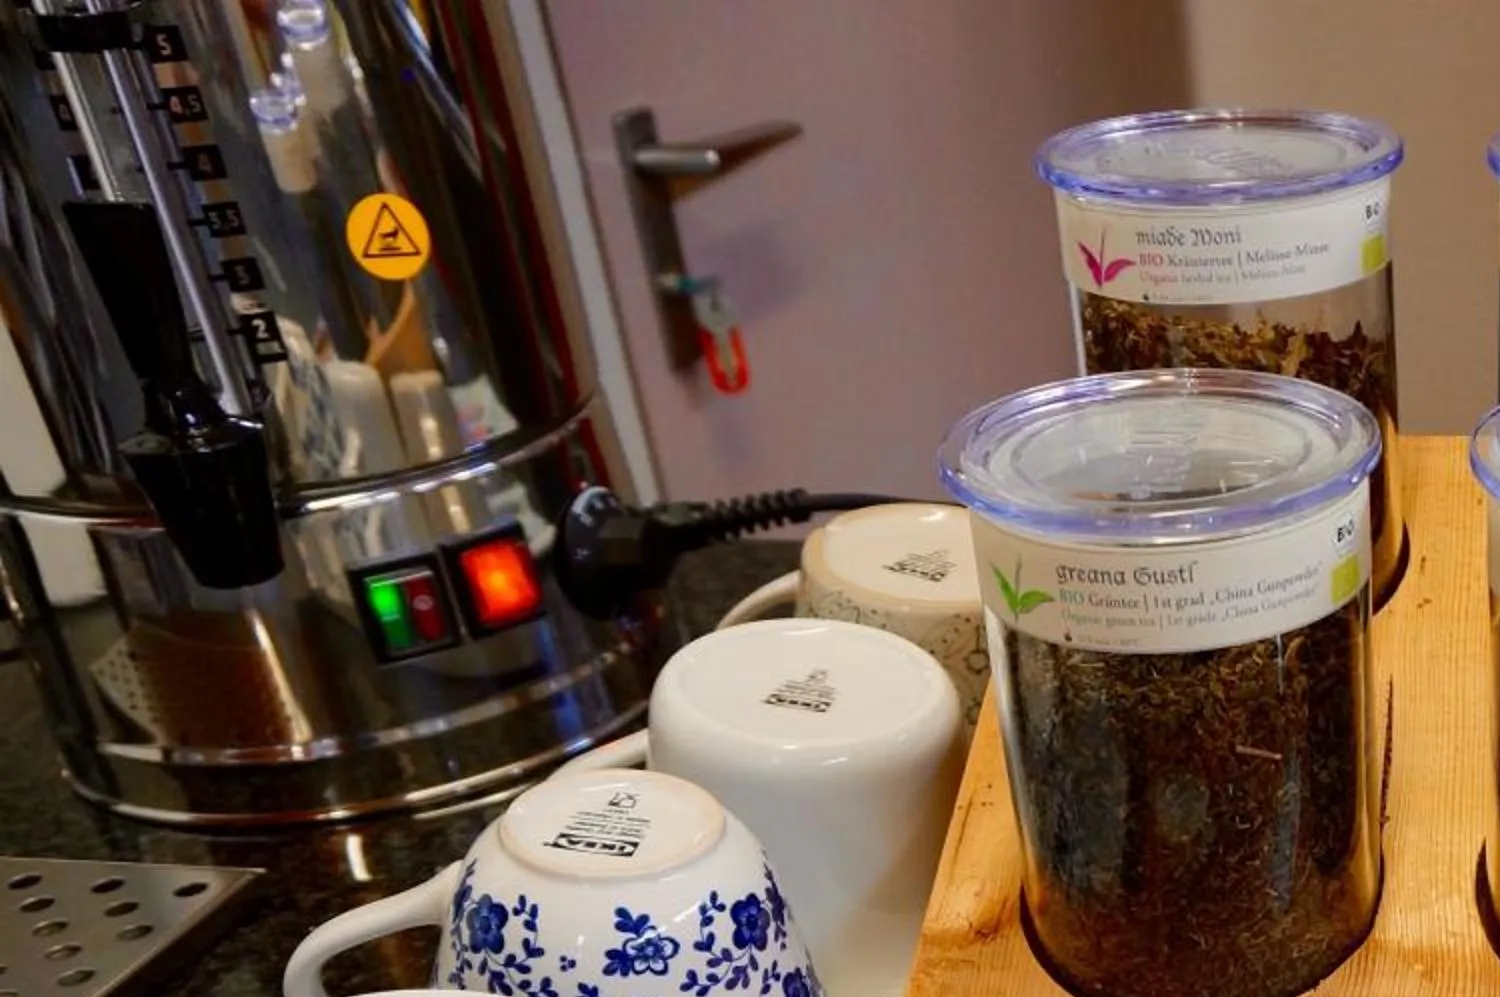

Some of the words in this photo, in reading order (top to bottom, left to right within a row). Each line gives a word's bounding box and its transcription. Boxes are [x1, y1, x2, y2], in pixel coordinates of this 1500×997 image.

[158, 33, 172, 57] 5
[252, 317, 268, 341] 2
[1055, 563, 1126, 587] greana
